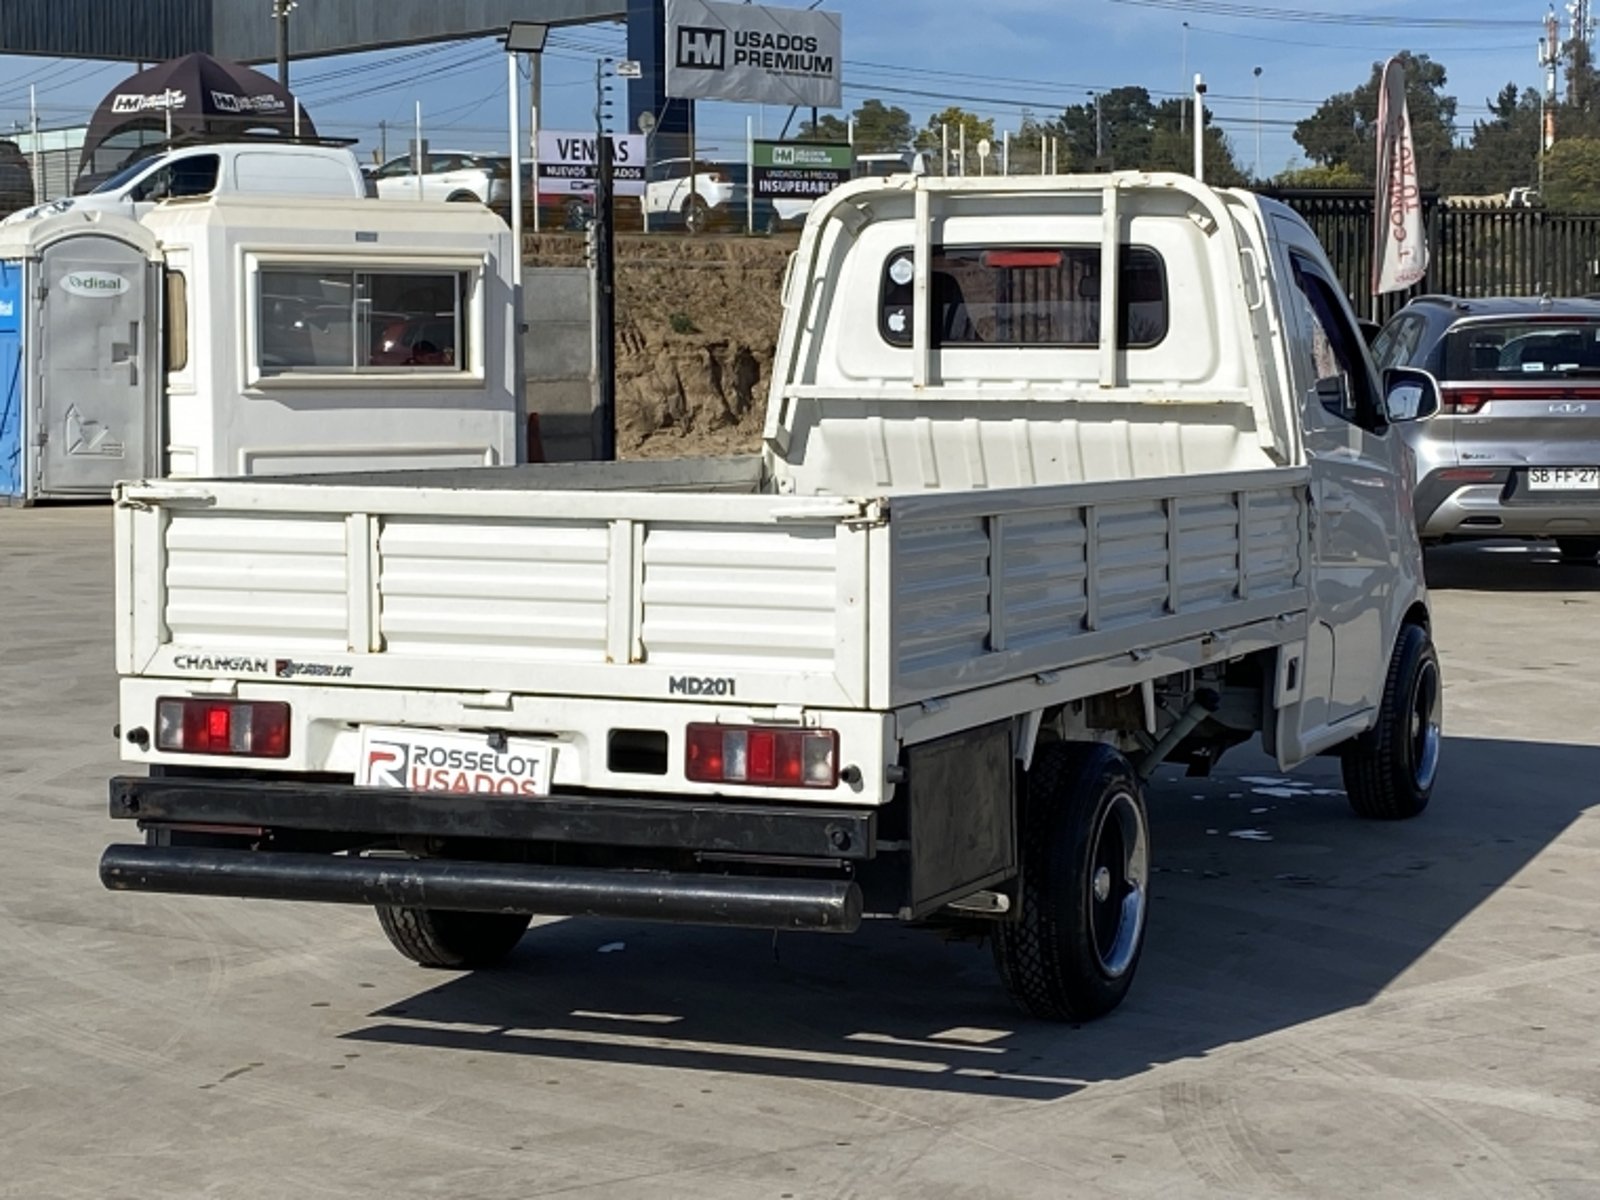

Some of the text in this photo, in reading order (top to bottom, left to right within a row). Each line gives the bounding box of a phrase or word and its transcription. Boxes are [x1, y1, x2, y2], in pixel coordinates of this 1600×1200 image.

[678, 27, 724, 69] HM
[734, 31, 818, 52] USADOS
[734, 50, 833, 73] PREMIUM
[546, 165, 586, 177] NUEVOS
[83, 277, 121, 290] disal
[1530, 468, 1550, 483] SB
[173, 654, 268, 673] CHANGAN
[669, 675, 736, 696] MD201
[412, 745, 540, 778] ROSSELOT
[411, 766, 537, 795] USADOS
